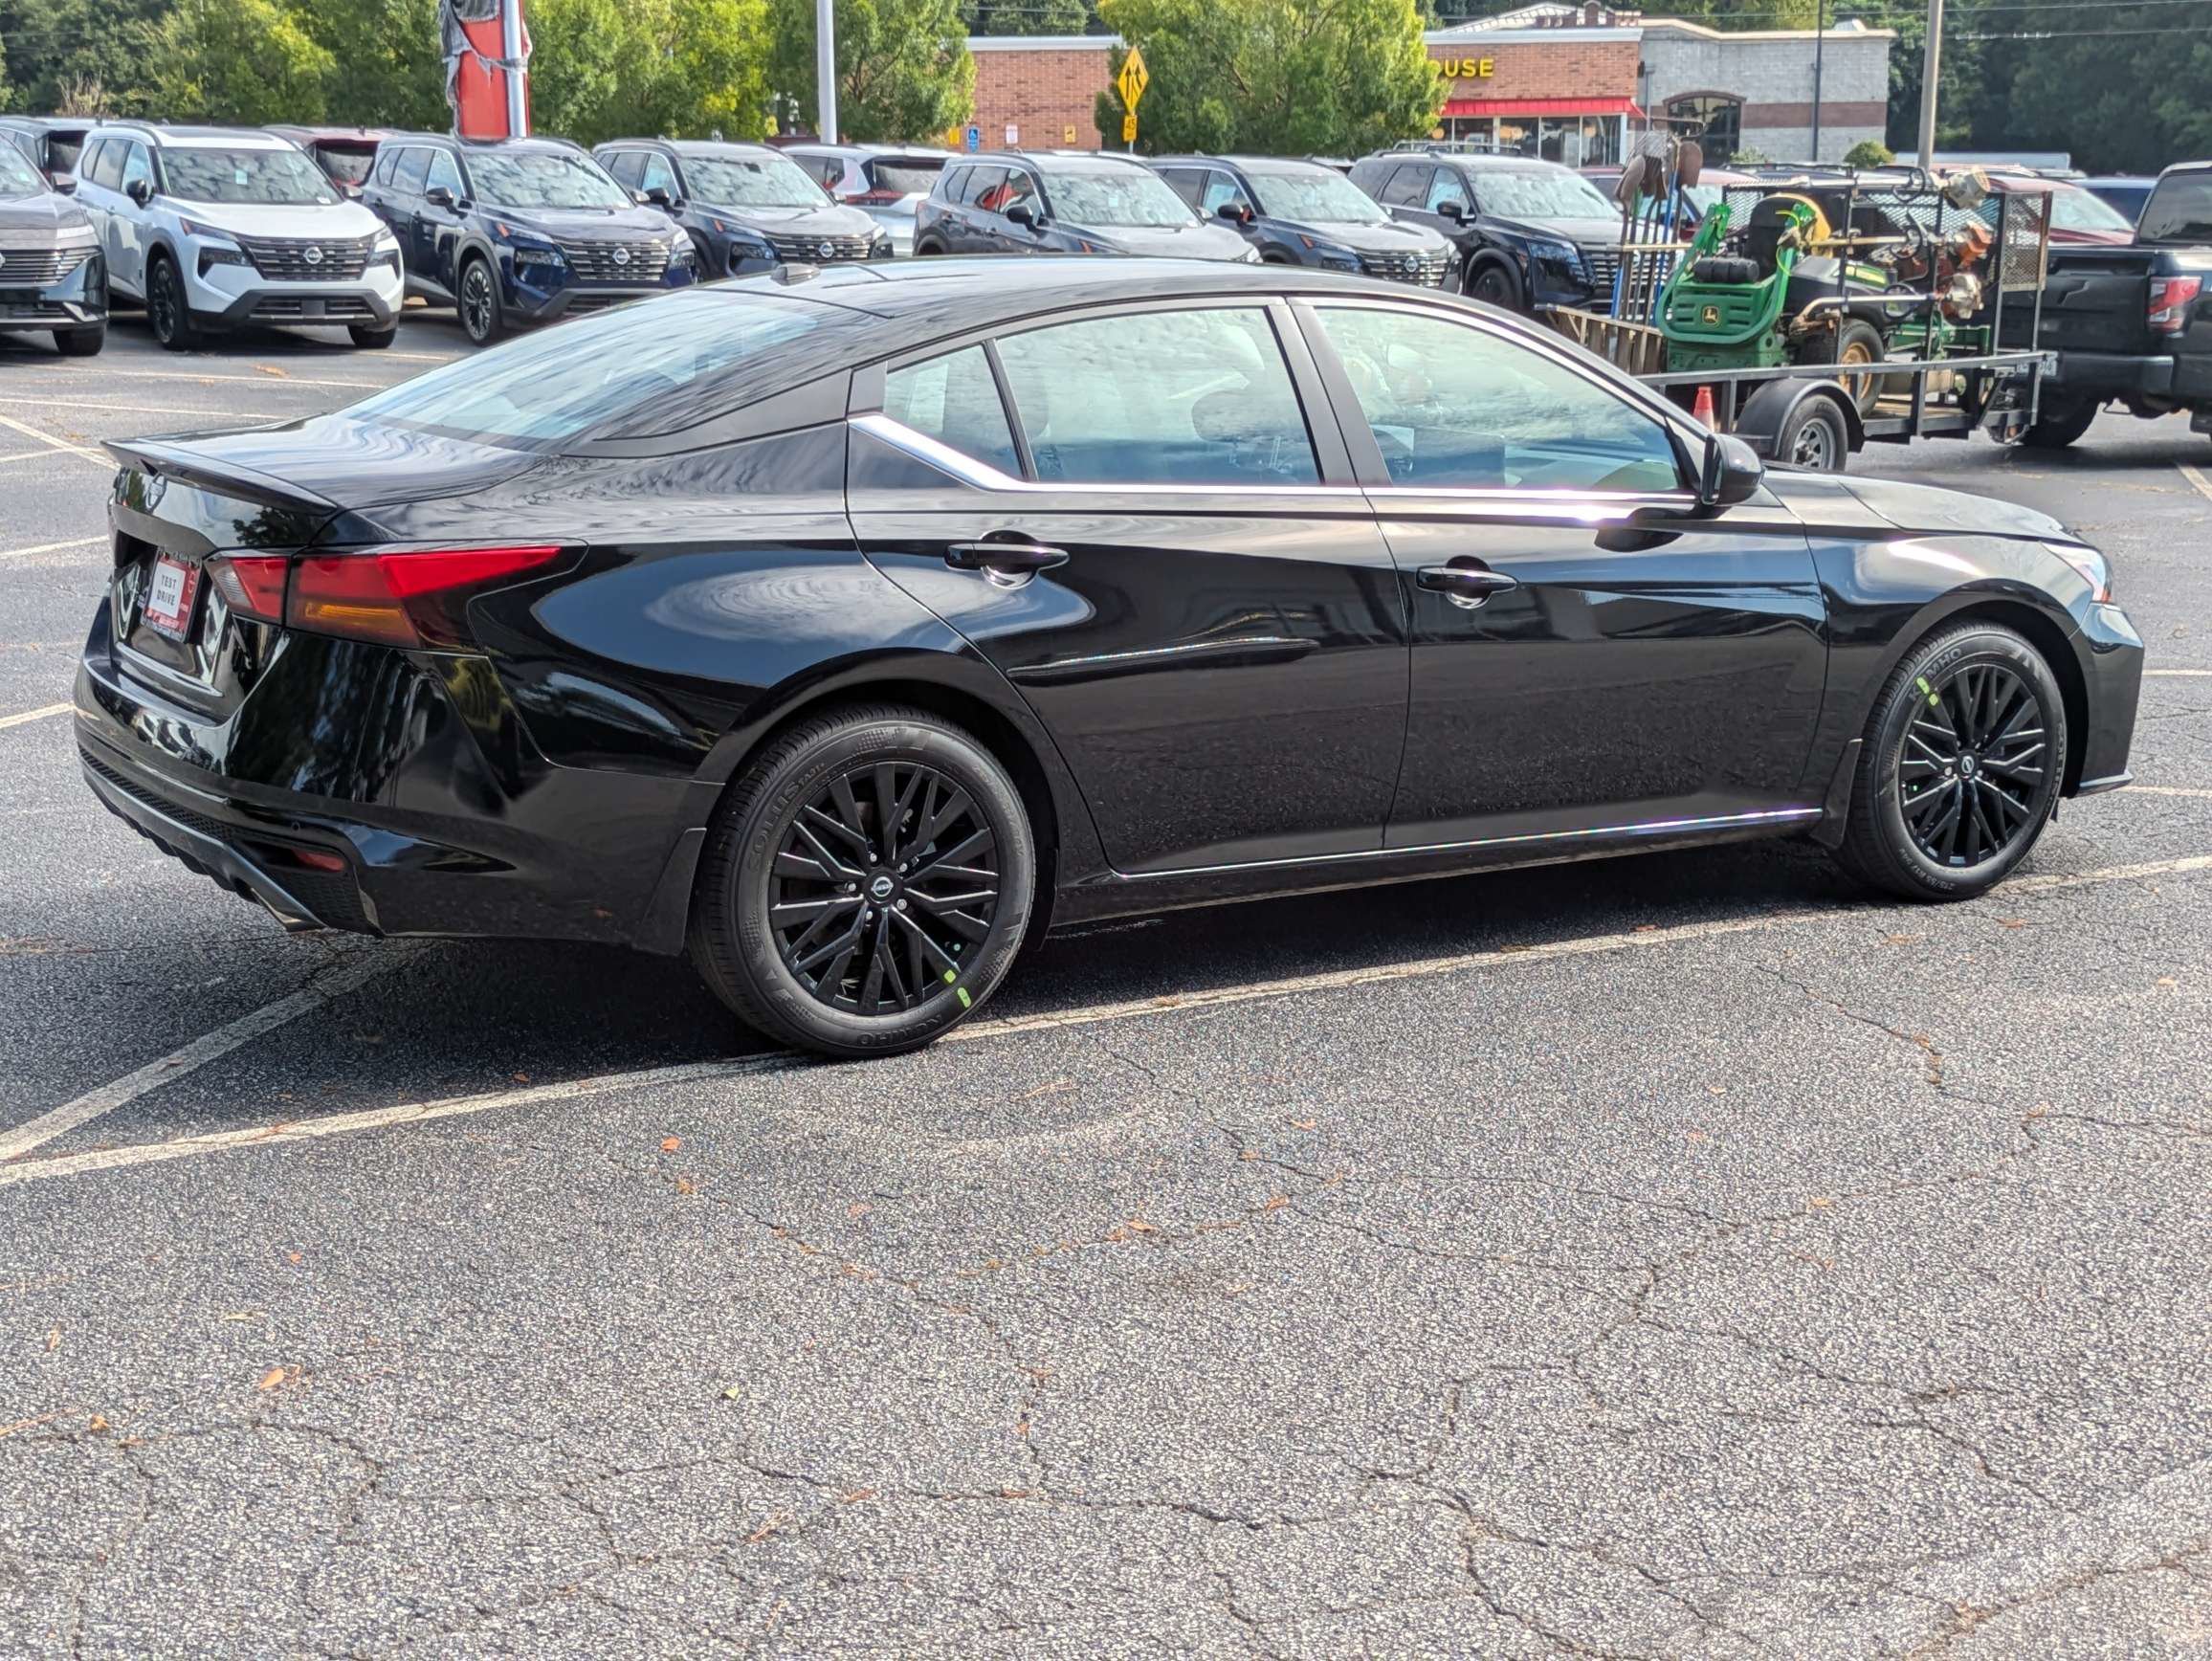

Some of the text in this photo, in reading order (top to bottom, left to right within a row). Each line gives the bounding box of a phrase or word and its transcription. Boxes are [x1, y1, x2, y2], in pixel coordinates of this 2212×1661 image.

[161, 574, 177, 589] TEST
[156, 589, 176, 606] DRIVE
[1909, 648, 1961, 702] KMHO
